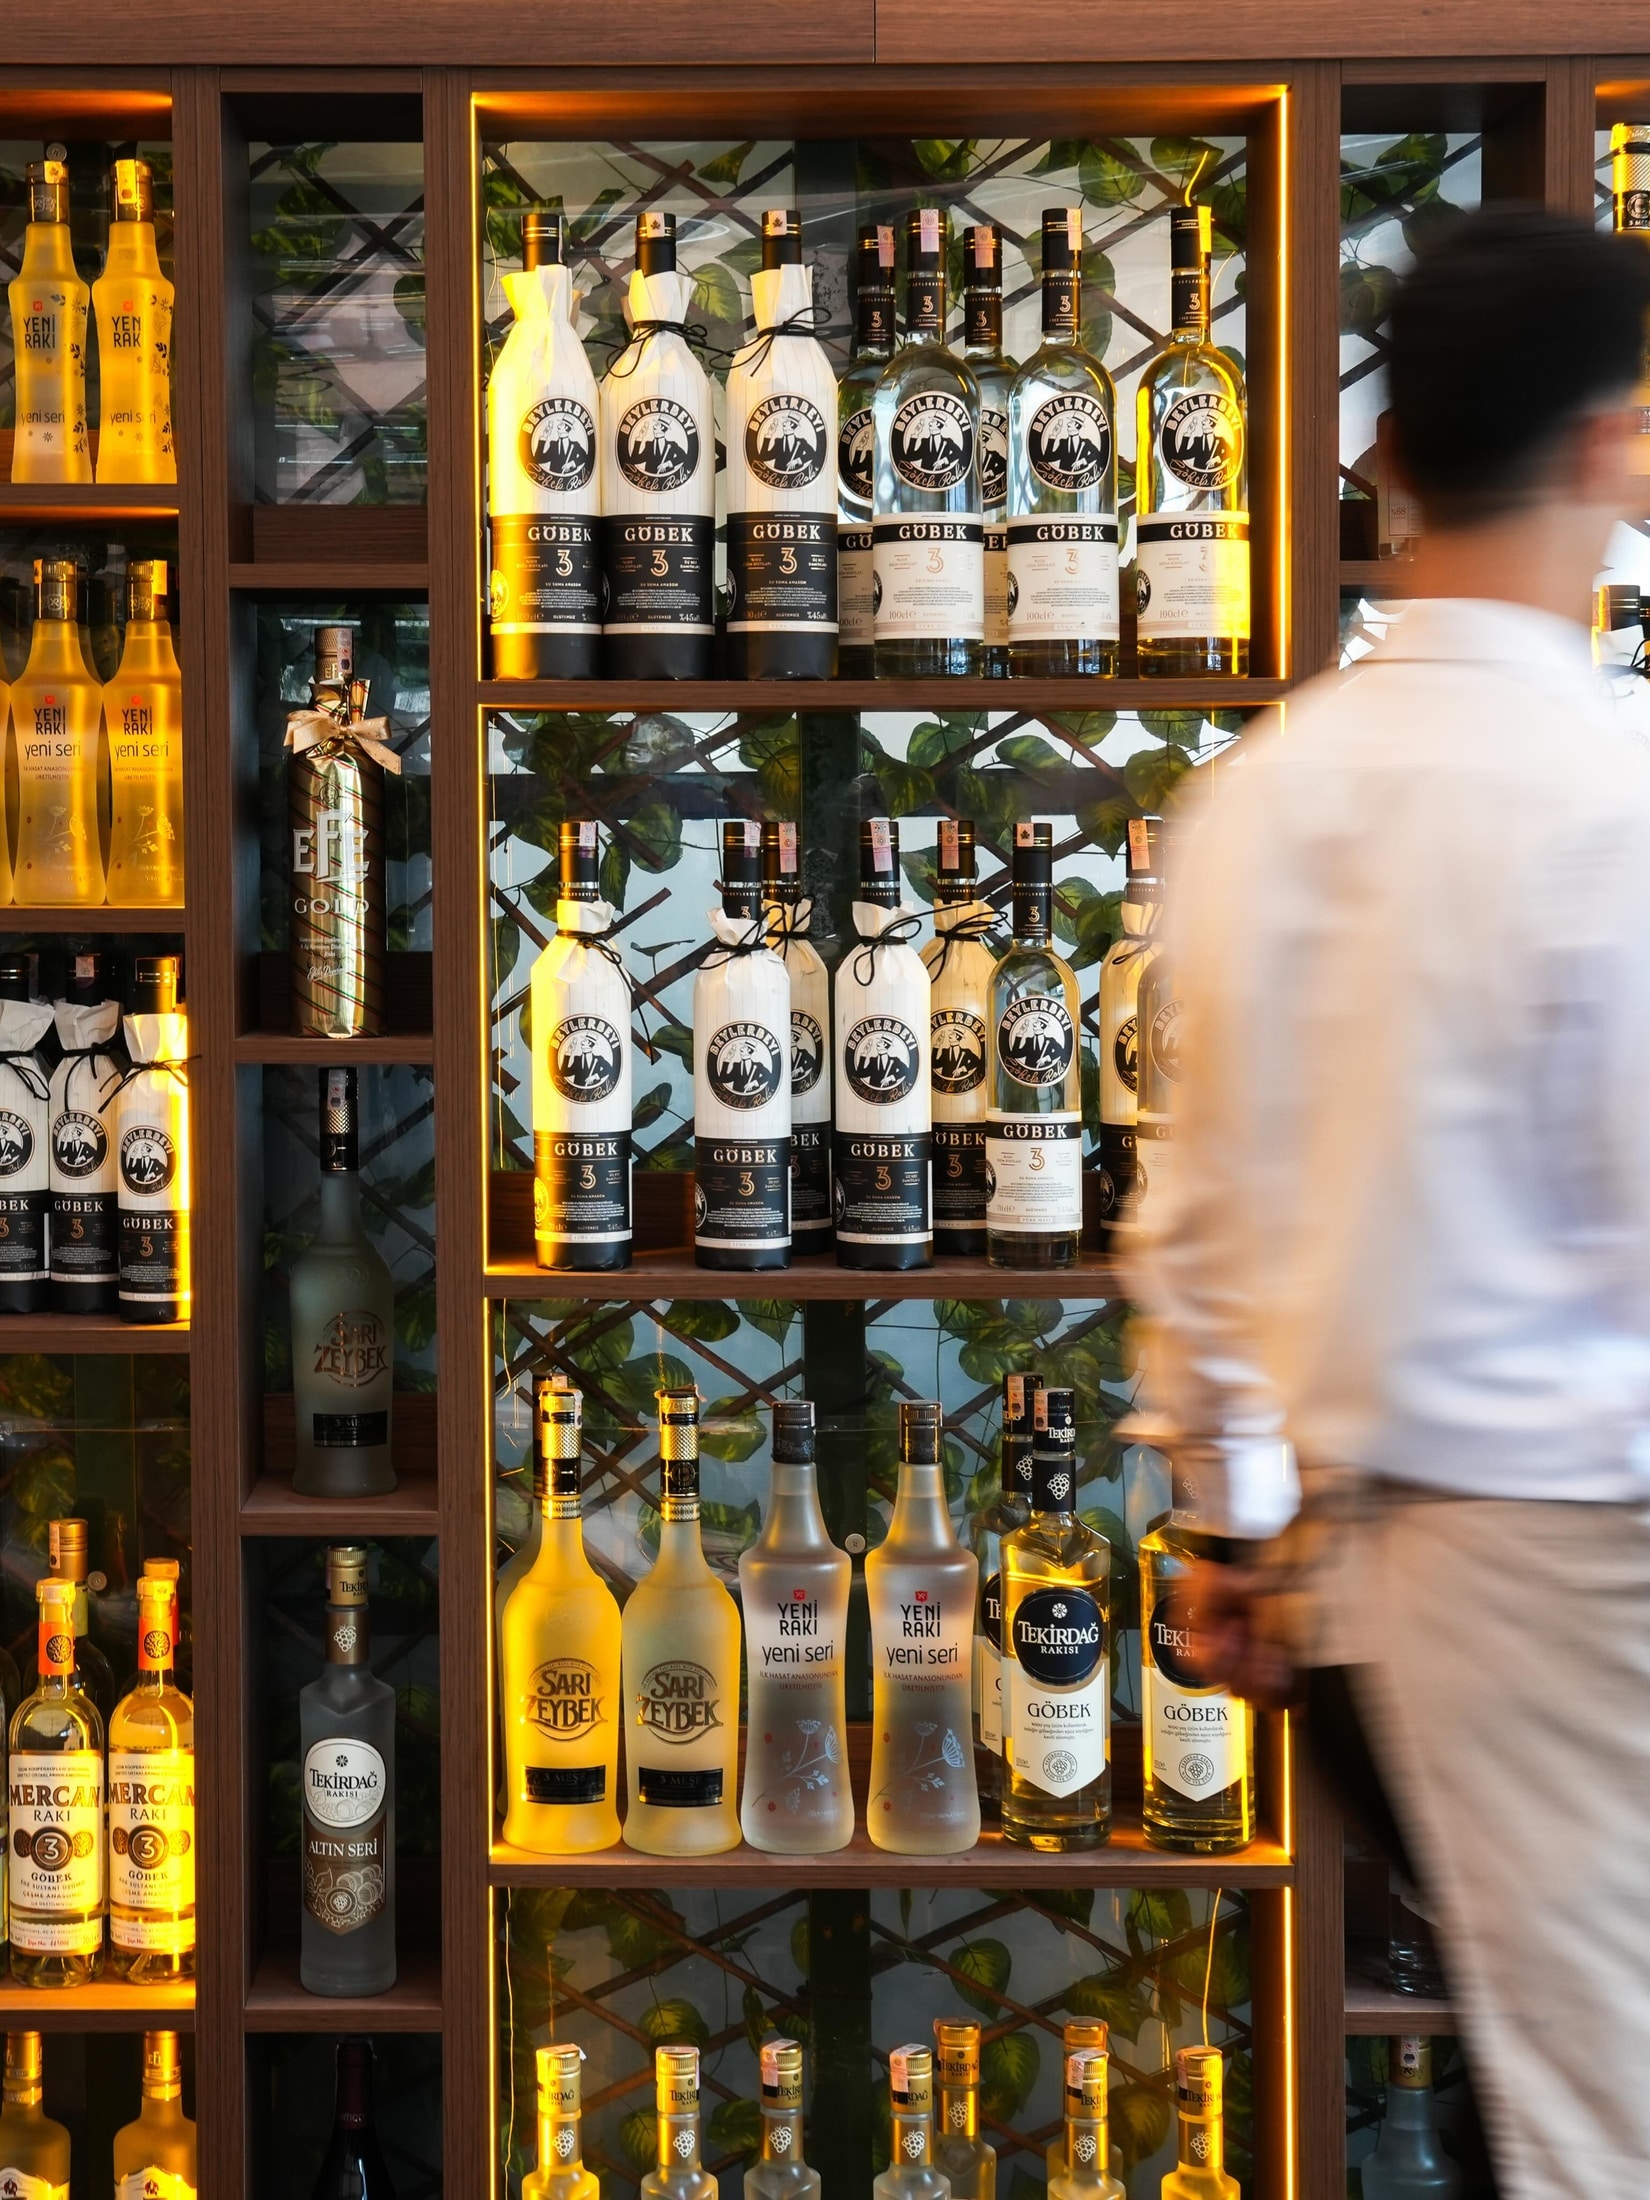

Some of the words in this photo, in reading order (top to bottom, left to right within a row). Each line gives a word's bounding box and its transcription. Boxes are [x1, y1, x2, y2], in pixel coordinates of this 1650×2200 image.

[922, 295, 934, 313] 3
[1059, 295, 1071, 312] 3
[1189, 293, 1201, 310] 3
[23, 313, 56, 333] YENİ
[111, 316, 142, 332] YEN
[24, 333, 56, 349] RAKI
[113, 332, 142, 348] RAK
[21, 410, 42, 426] yeni
[44, 410, 65, 423] seri
[110, 410, 133, 425] yeni
[136, 410, 156, 423] sri
[522, 399, 594, 436] BEYLERBEYI
[620, 399, 697, 435] BEYLERBEYI
[748, 396, 824, 432] BEYLERBEYI
[894, 396, 971, 432] BEYLERBEYI
[1032, 397, 1107, 433] BEYLERBEYI
[528, 525, 591, 541] GÖBEK
[625, 526, 693, 542] GÖBEK
[753, 524, 820, 540] GÖBEK
[899, 524, 967, 540] GÖBEK
[1037, 524, 1104, 540] GÖBEK
[1170, 522, 1238, 539] GÖBEK
[556, 549, 573, 577] 3
[650, 549, 669, 577] 3
[779, 547, 798, 575] 3
[926, 547, 944, 574] 3
[1064, 548, 1080, 575] 3
[34, 705, 66, 721] YENİ
[122, 705, 153, 722] YENİ
[36, 722, 66, 735] RAKI
[124, 722, 153, 735] RAKI
[25, 740, 51, 760] yeni
[56, 740, 81, 757] seri
[114, 741, 138, 761] yeni
[142, 741, 169, 757] seri
[292, 809, 370, 880] EFE
[294, 897, 370, 915] GOLD
[1028, 906, 1040, 923] 3
[1002, 998, 1071, 1031] BEYLERBEYI
[550, 1016, 620, 1049] BEYLERBEYI
[711, 1023, 780, 1056] BEYLERBEYI
[847, 1017, 918, 1050] BEYLERBEYI
[791, 1133, 820, 1147] BEK
[936, 1132, 985, 1145] ÖBEK
[1003, 1124, 1068, 1139] GÖBEK
[554, 1141, 618, 1157] GÖBEK
[714, 1148, 778, 1163] GÖBEK
[850, 1142, 915, 1158] GÖBEK
[1028, 1147, 1045, 1171] 3
[946, 1154, 963, 1178] 3
[579, 1165, 597, 1190] 3
[738, 1172, 755, 1197] 3
[874, 1165, 892, 1191] 3
[0, 1199, 29, 1211] BEK
[54, 1199, 104, 1212] GÖBEK
[70, 1218, 84, 1239] 3
[123, 1216, 174, 1230] GÖBEK
[139, 1236, 153, 1257] 3
[330, 1321, 377, 1346] SARI
[313, 1343, 390, 1374] ZEYBEK
[777, 1599, 818, 1620] YENİ
[900, 1601, 941, 1621] YENİ
[779, 1619, 817, 1636] RAKI
[903, 1621, 940, 1637] RAKI
[1017, 1620, 1100, 1645] TEKİRDAĞ
[1153, 1622, 1191, 1647] TEKİ
[762, 1643, 799, 1666] yeni
[804, 1640, 833, 1662] seri
[886, 1644, 922, 1667] yeni
[928, 1642, 958, 1665] seri
[1040, 1645, 1079, 1654] RAKISI
[537, 1668, 591, 1696] SARI
[650, 1671, 705, 1700] SARI
[769, 1672, 790, 1680] HASAT
[525, 1695, 608, 1730] ZEYBEK
[636, 1693, 724, 1731] ZEYBEK
[1027, 1700, 1092, 1719] GÖBEK
[1163, 1703, 1229, 1722] GÖBEK
[309, 1767, 378, 1790] TEKİRDAĞ
[10, 1784, 101, 1808] MERCAN
[109, 1782, 196, 1806] MERCAN
[326, 1790, 358, 1798] RAKISI
[33, 1809, 71, 1822] RAKI
[130, 1808, 167, 1820] RAKI
[42, 1838, 59, 1861] 3
[138, 1836, 155, 1859] 3
[308, 1839, 346, 1856] ALTIN
[348, 1837, 378, 1857] SERİ
[31, 1872, 73, 1883] GÖBEK
[128, 1870, 168, 1881] GÖBEK
